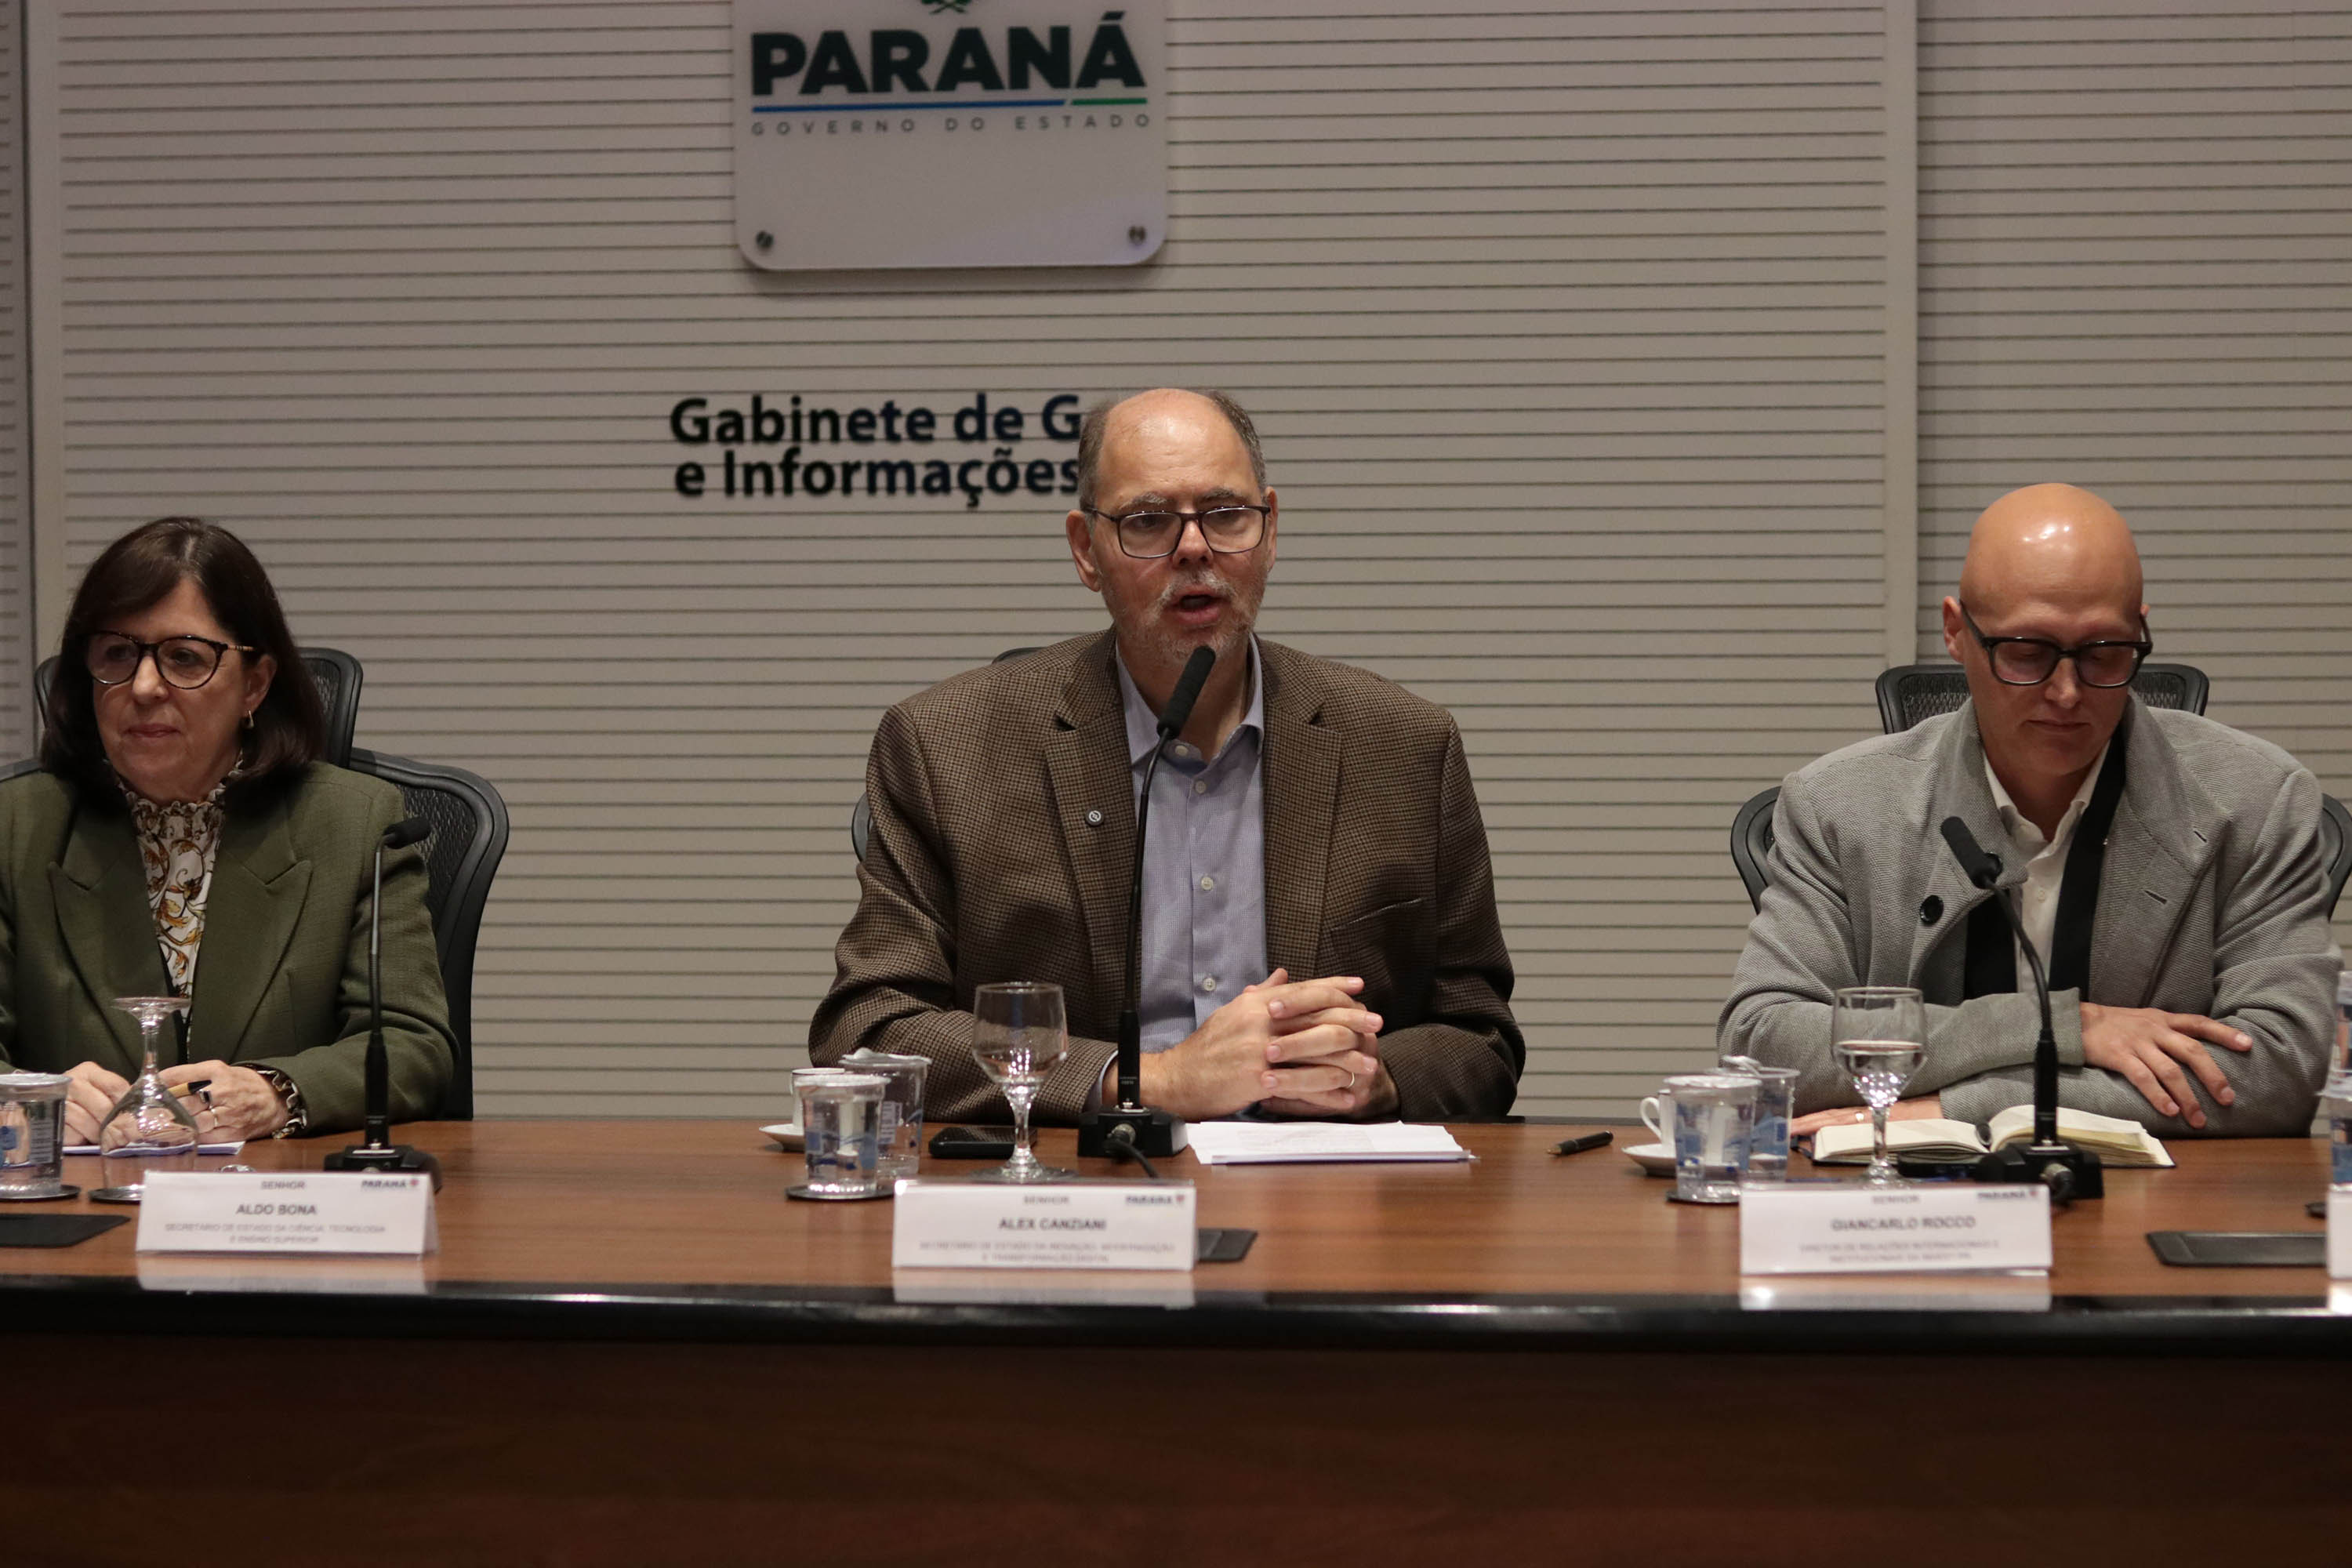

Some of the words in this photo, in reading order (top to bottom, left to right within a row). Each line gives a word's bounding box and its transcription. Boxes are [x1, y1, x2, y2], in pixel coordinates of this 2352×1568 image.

[751, 11, 1146, 96] PARANÁ
[752, 118, 914, 136] GOVERNO
[945, 116, 985, 131] DO
[1015, 113, 1149, 130] ESTADO
[670, 393, 936, 445] Gabinete
[953, 392, 1025, 441] de
[674, 460, 706, 496] e
[724, 445, 1080, 508] Informações
[235, 1203, 274, 1215] ALDO
[278, 1204, 318, 1215] BONA
[998, 1217, 1036, 1231] ALEX
[1831, 1217, 1918, 1232] GIANCARLO
